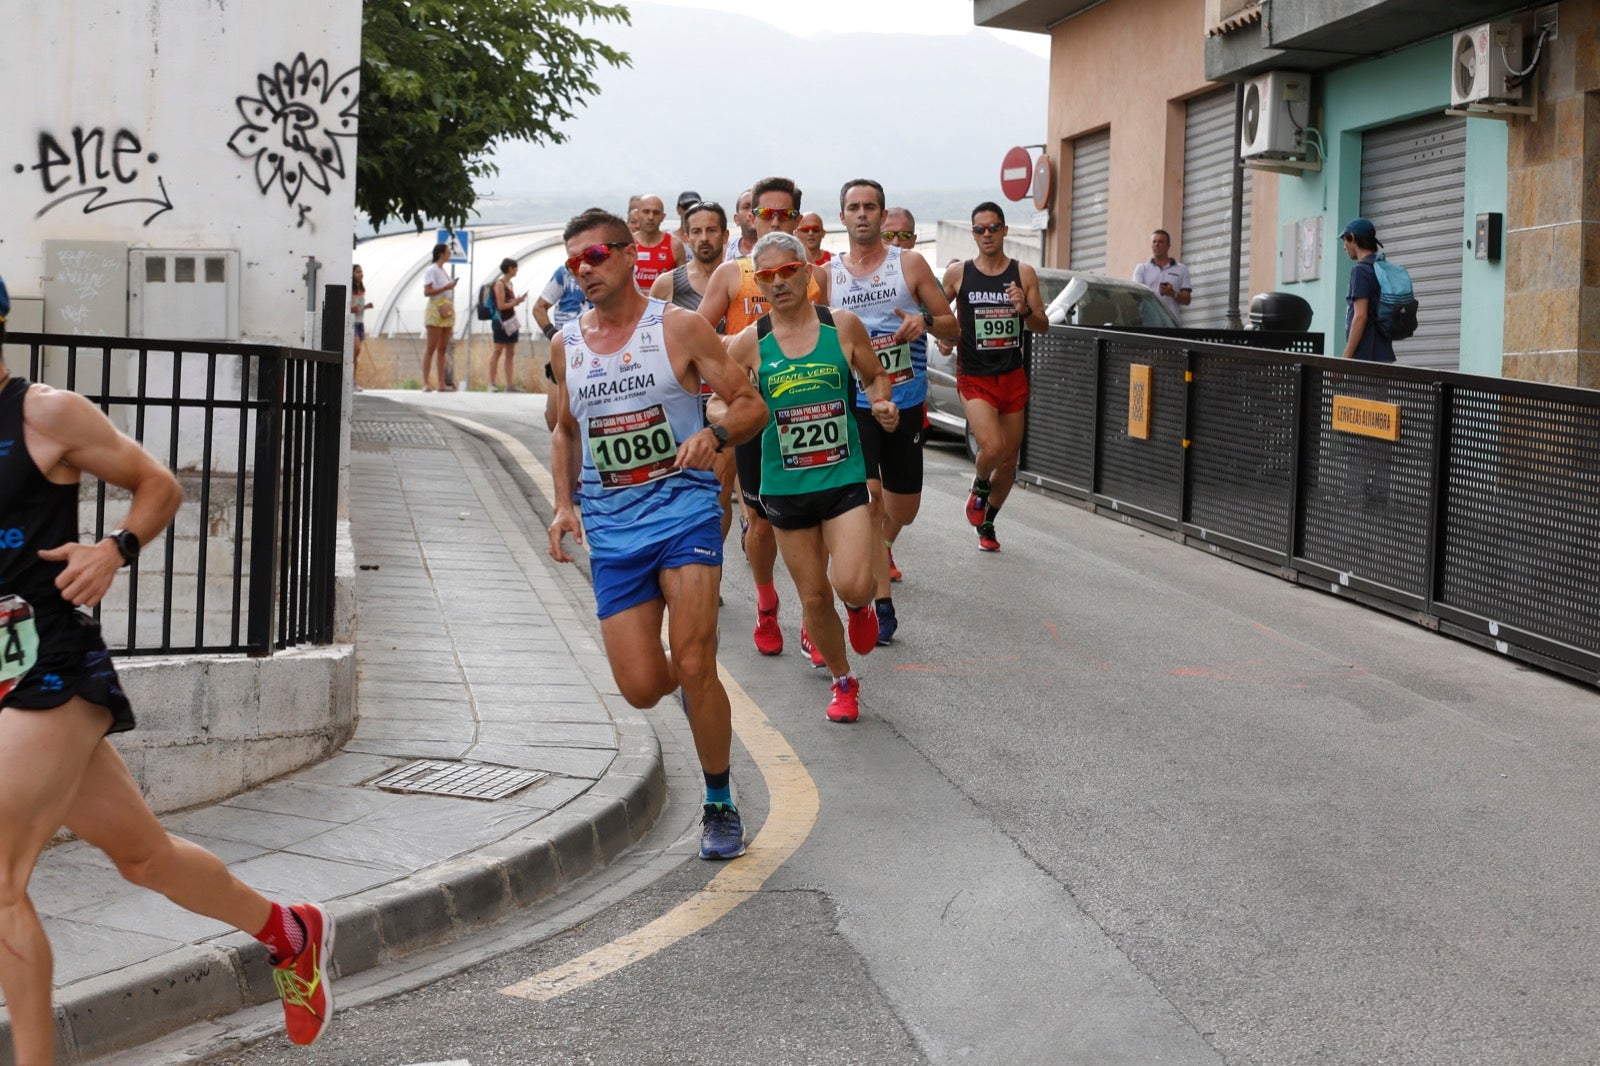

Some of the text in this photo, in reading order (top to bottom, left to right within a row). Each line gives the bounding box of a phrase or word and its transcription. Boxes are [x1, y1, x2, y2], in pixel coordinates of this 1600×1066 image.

[841, 288, 897, 306] MARACENA
[968, 291, 1012, 301] GRANAD
[983, 320, 1015, 335] 998
[768, 367, 838, 384] PUENTE VERDE
[578, 373, 656, 400] MARACENA
[788, 384, 821, 395] Granada
[613, 391, 647, 402] ATLETISMO
[1337, 405, 1391, 431] CERVEZAS ALHAMBRA
[790, 421, 839, 449] 220
[596, 428, 671, 466] 1080
